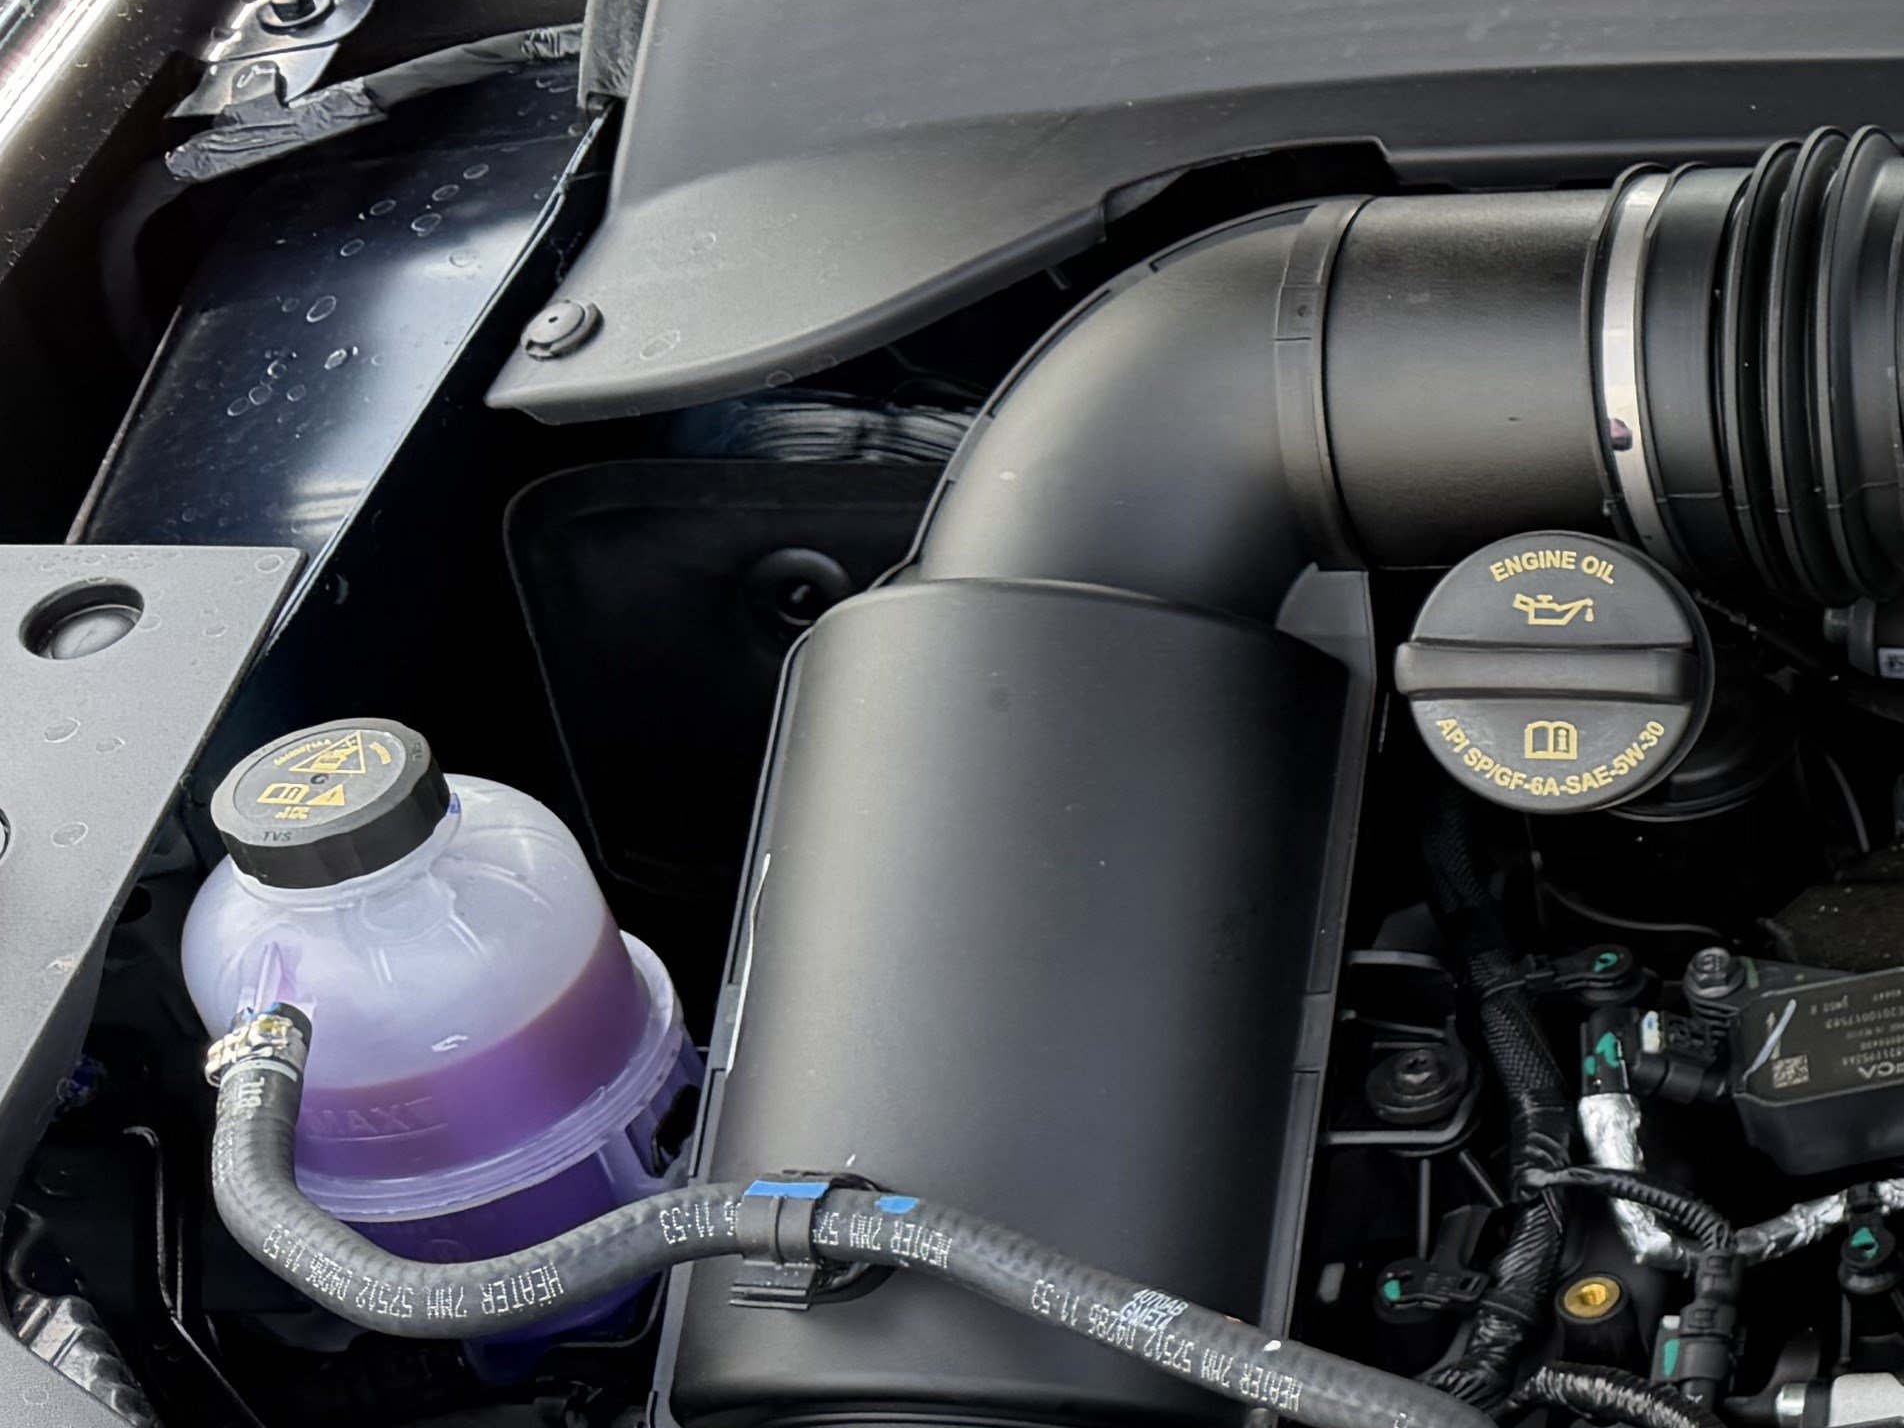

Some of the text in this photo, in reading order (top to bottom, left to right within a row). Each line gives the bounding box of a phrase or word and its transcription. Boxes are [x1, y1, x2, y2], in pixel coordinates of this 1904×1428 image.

[1490, 550, 1616, 584] ENGINE OIL
[1436, 716, 1470, 754] API
[263, 830, 293, 842] TVS
[659, 1203, 714, 1244] 11:53
[890, 1221, 952, 1269] HEATER
[355, 1276, 413, 1319] 57512
[480, 1265, 564, 1317] HEATER
[1239, 1363, 1301, 1412] HEATER
